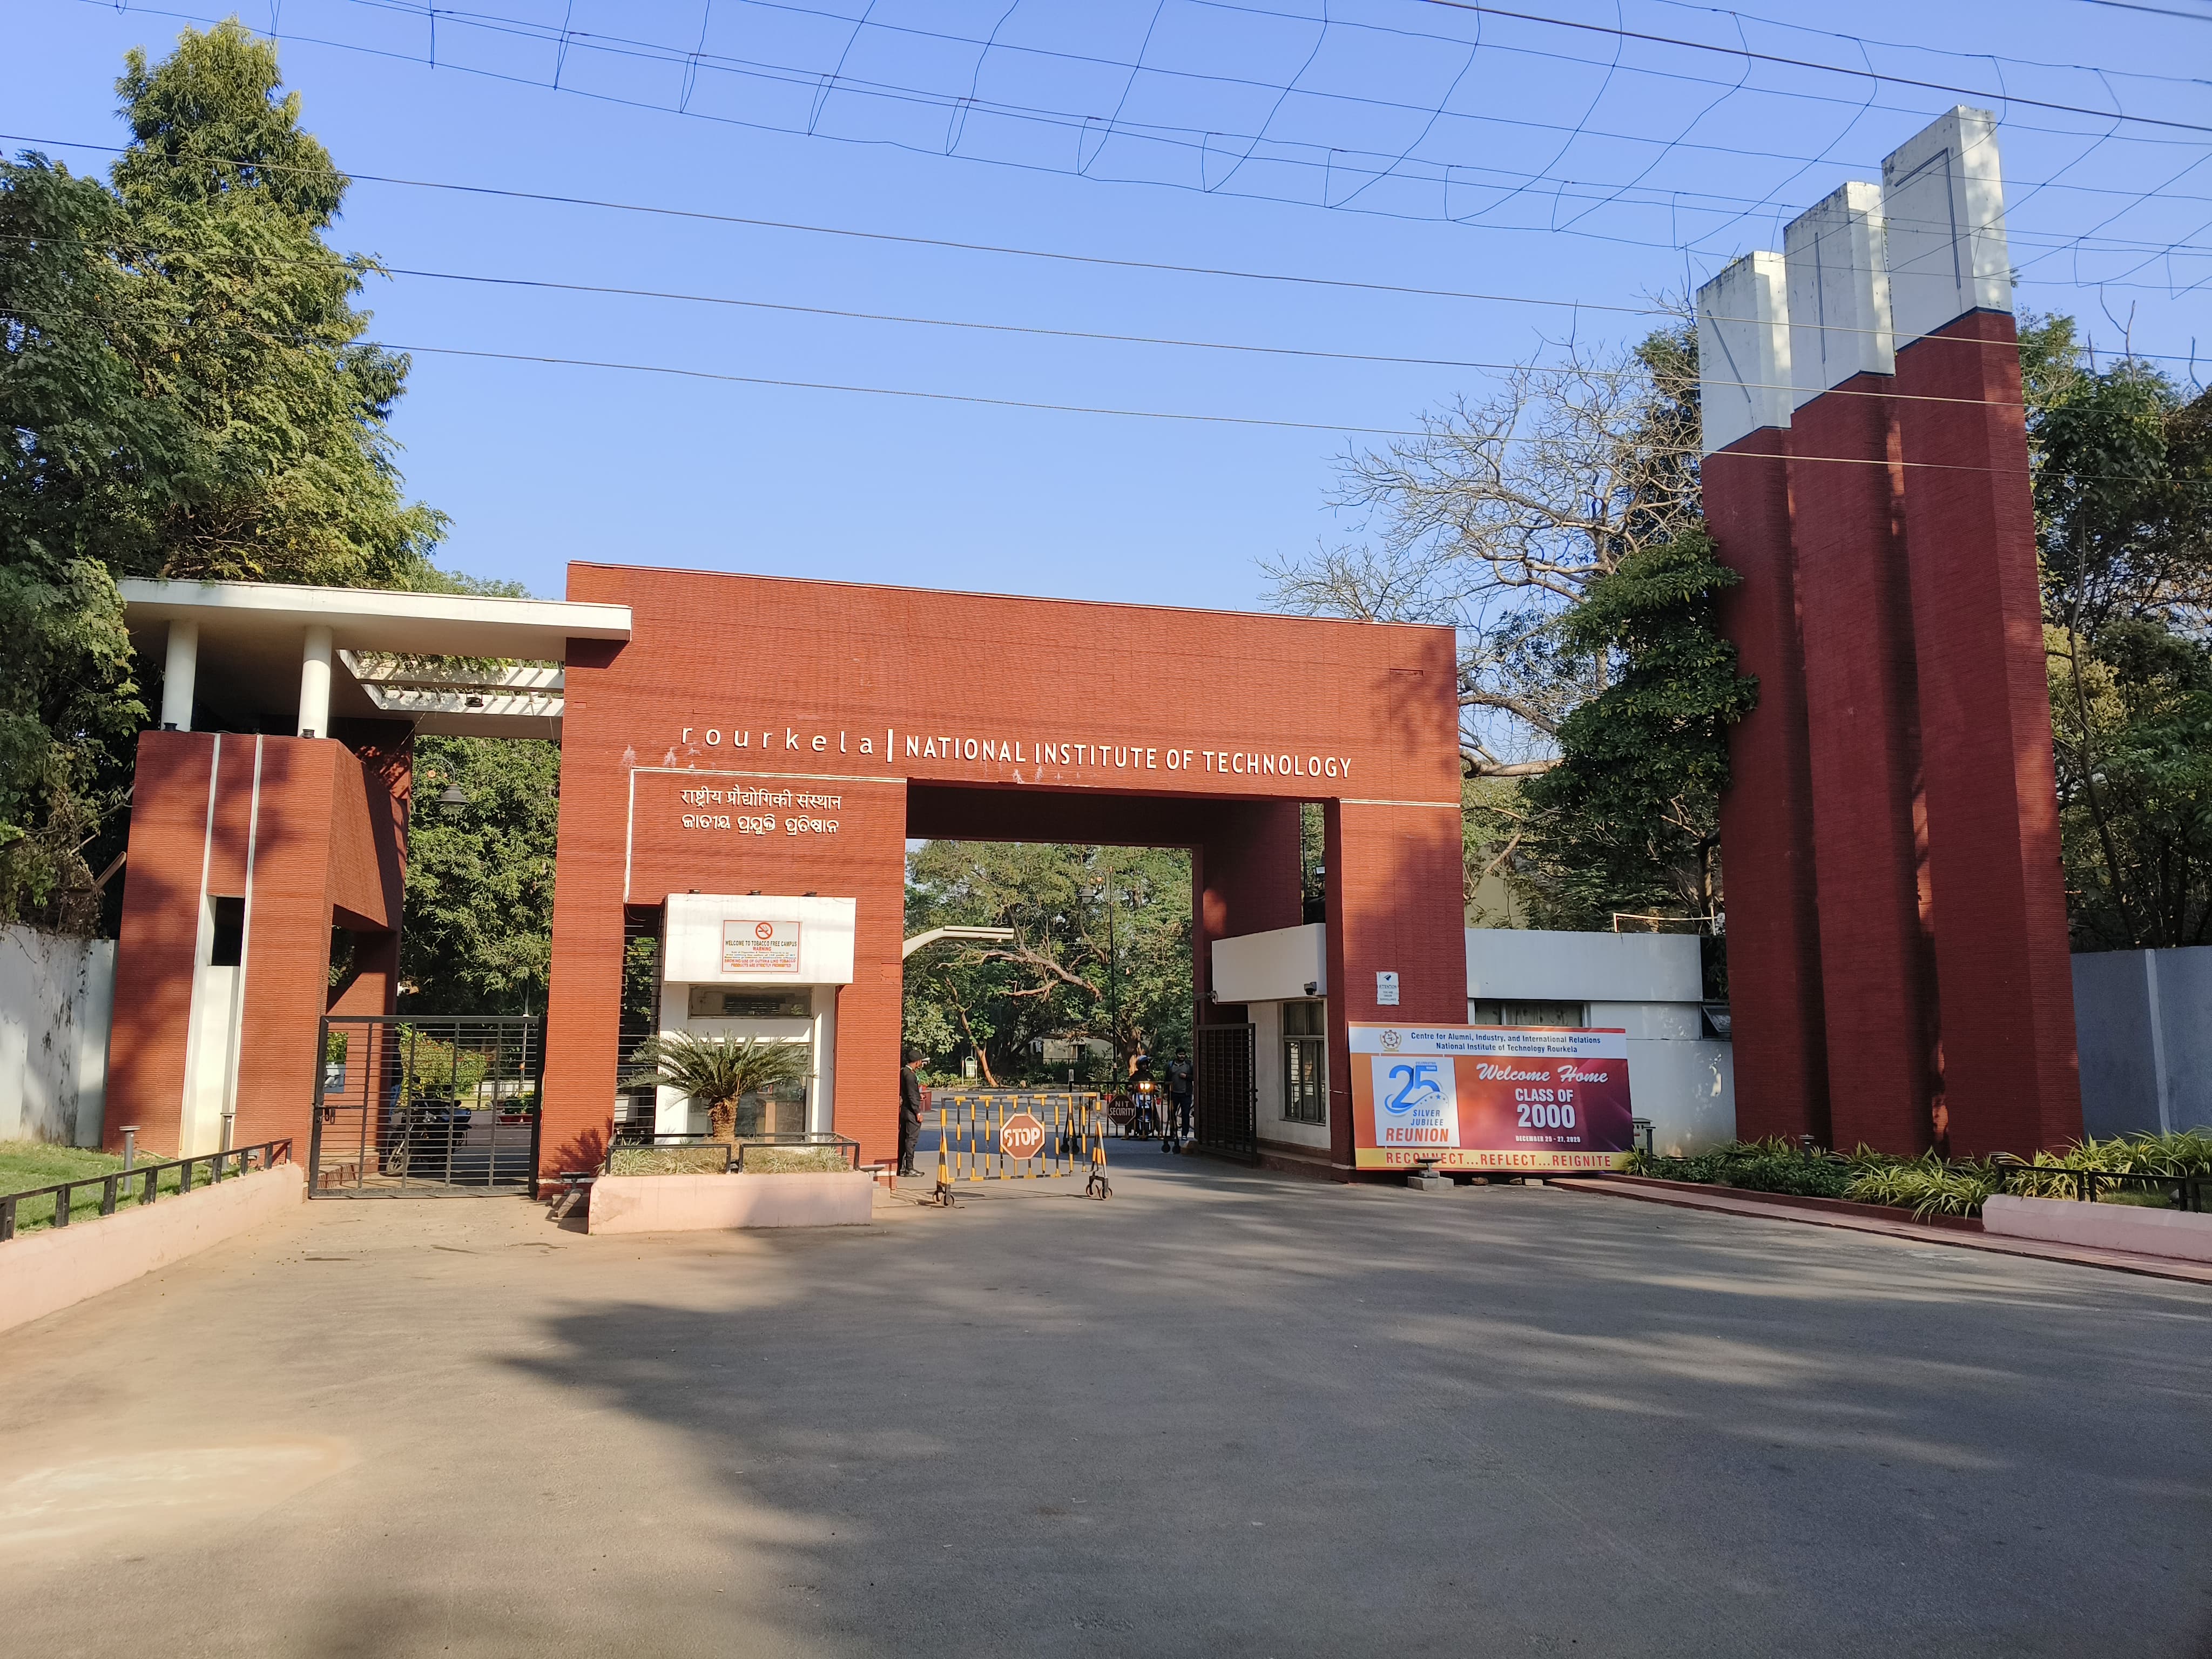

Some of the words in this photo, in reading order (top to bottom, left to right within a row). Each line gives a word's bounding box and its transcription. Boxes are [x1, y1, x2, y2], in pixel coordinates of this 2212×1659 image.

[682, 726, 873, 754] rourkela
[906, 734, 1026, 763] NATIONAL
[1035, 743, 1157, 769] INSTITUTE
[1165, 748, 1194, 770] OF
[1202, 751, 1352, 778] TECHNOLOGY
[680, 785, 723, 808] राष्ट्रीय
[726, 784, 793, 808] प्रौद्योगिकी
[795, 791, 842, 810] संस्थान
[682, 814, 731, 829] ଜାତୀୟ
[1448, 1033, 1473, 1041] Alumni,
[1476, 1034, 1506, 1042] Industry,
[1507, 1044, 1545, 1053] Technology
[1476, 1063, 1550, 1082] Welcome
[1557, 1064, 1608, 1083] Home
[1389, 1064, 1440, 1108] 25
[1515, 1088, 1554, 1102] CLASS
[1557, 1089, 1573, 1102] OF
[1109, 1107, 1134, 1116] SECURITY
[1516, 1103, 1576, 1128] 2000
[1004, 1127, 1040, 1147] STOP
[1386, 1128, 1449, 1142] REUNION
